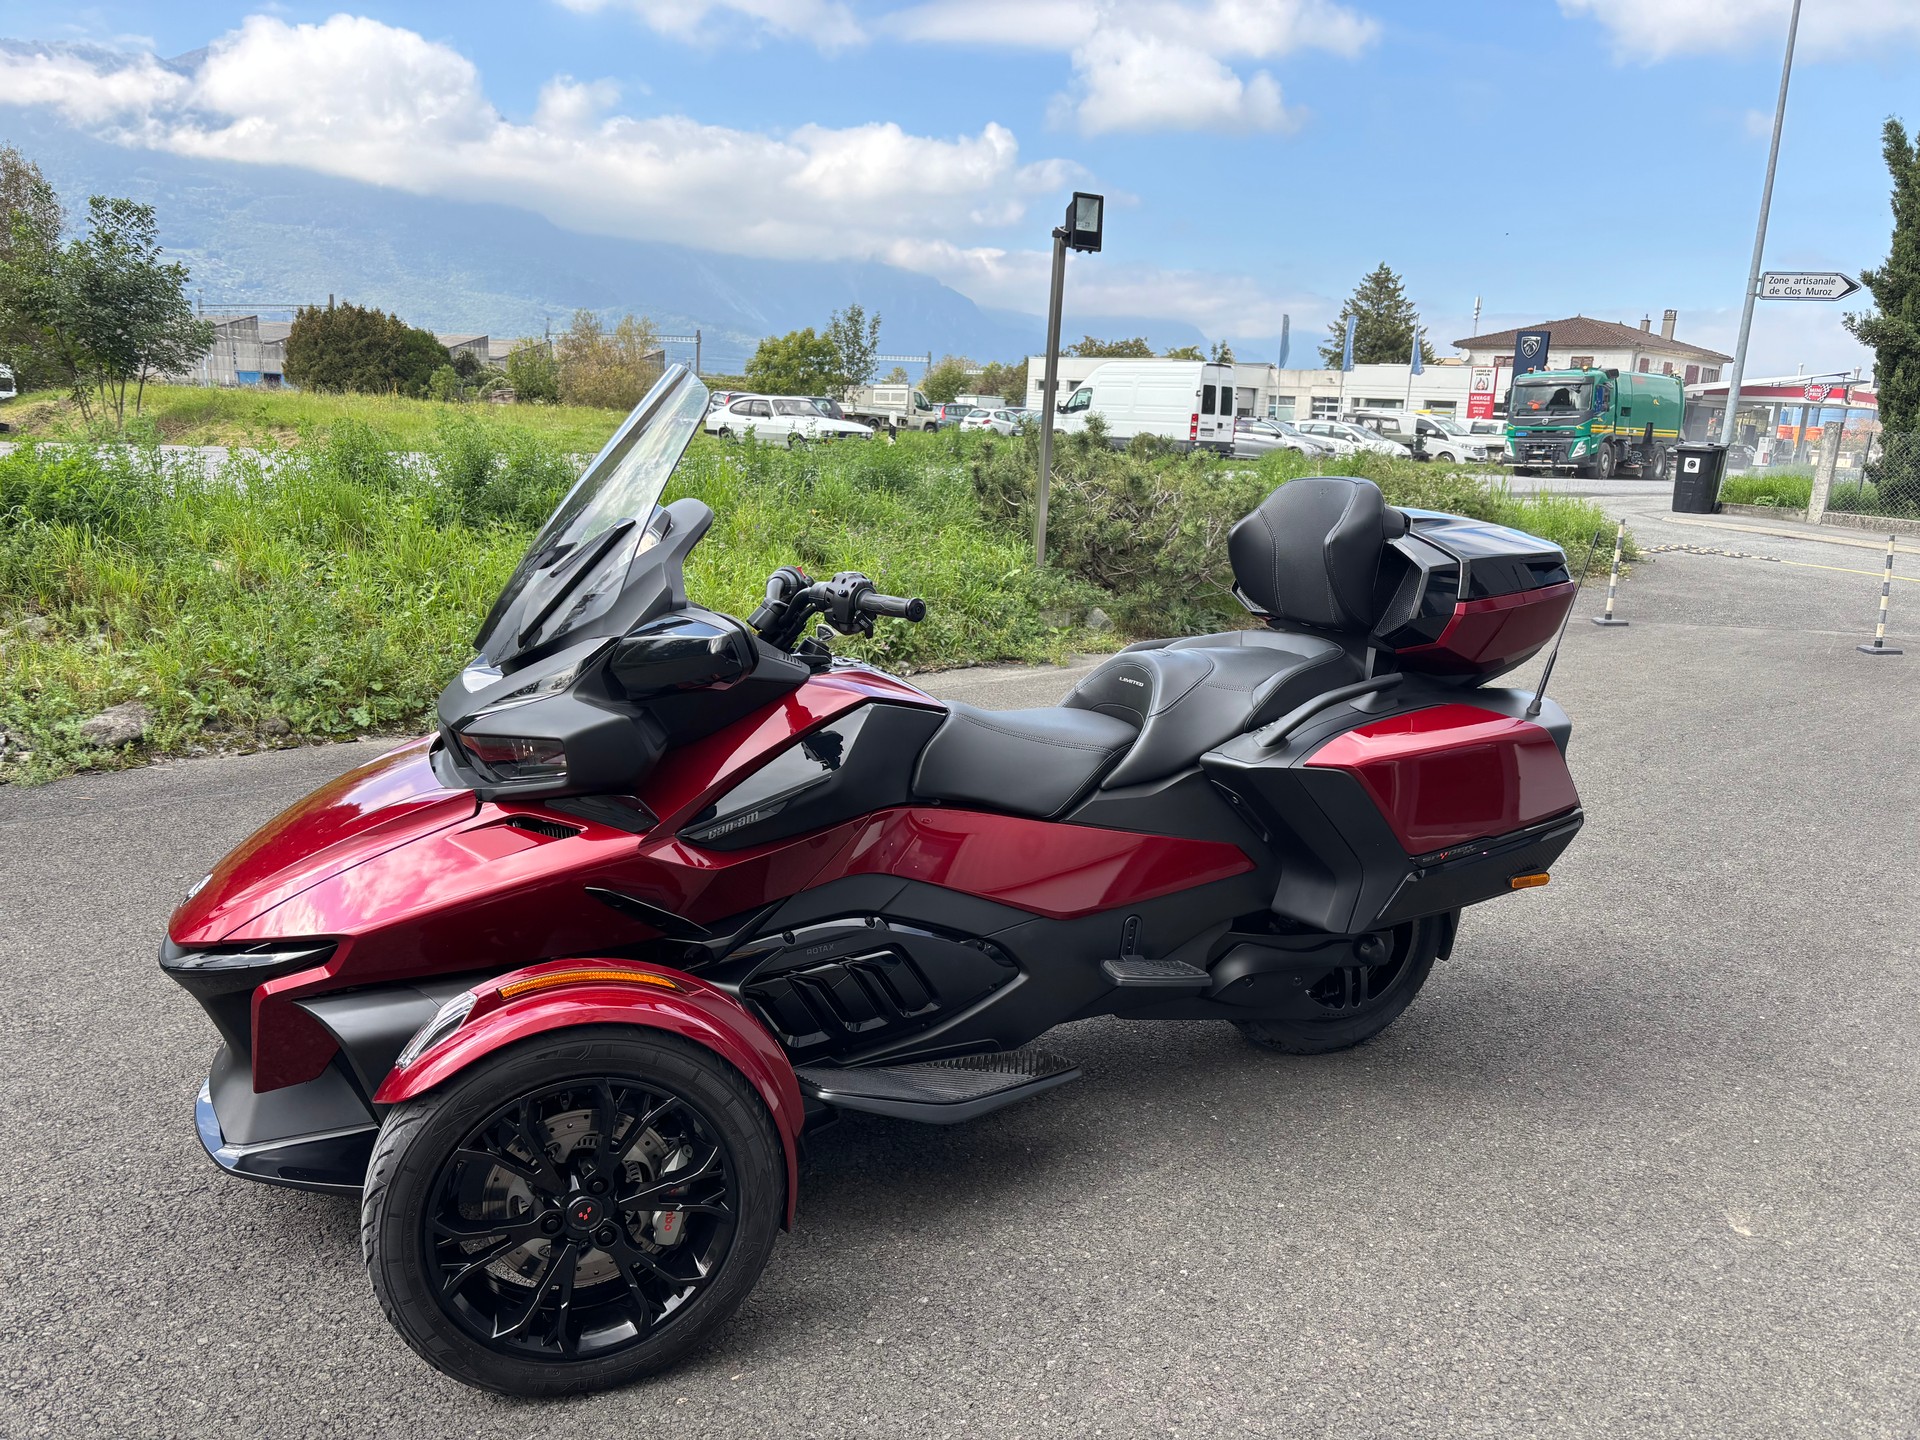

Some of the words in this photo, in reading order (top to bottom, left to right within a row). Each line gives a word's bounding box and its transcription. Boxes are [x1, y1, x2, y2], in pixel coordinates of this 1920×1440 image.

[1769, 276, 1790, 285] Zone
[1793, 276, 1837, 286] artisanale
[1769, 286, 1780, 295] de
[1784, 286, 1802, 295] Clos
[1805, 287, 1833, 296] Muroz
[1119, 677, 1144, 687] LIMITED
[708, 811, 759, 840] can-am
[806, 943, 835, 956] ROTAX
